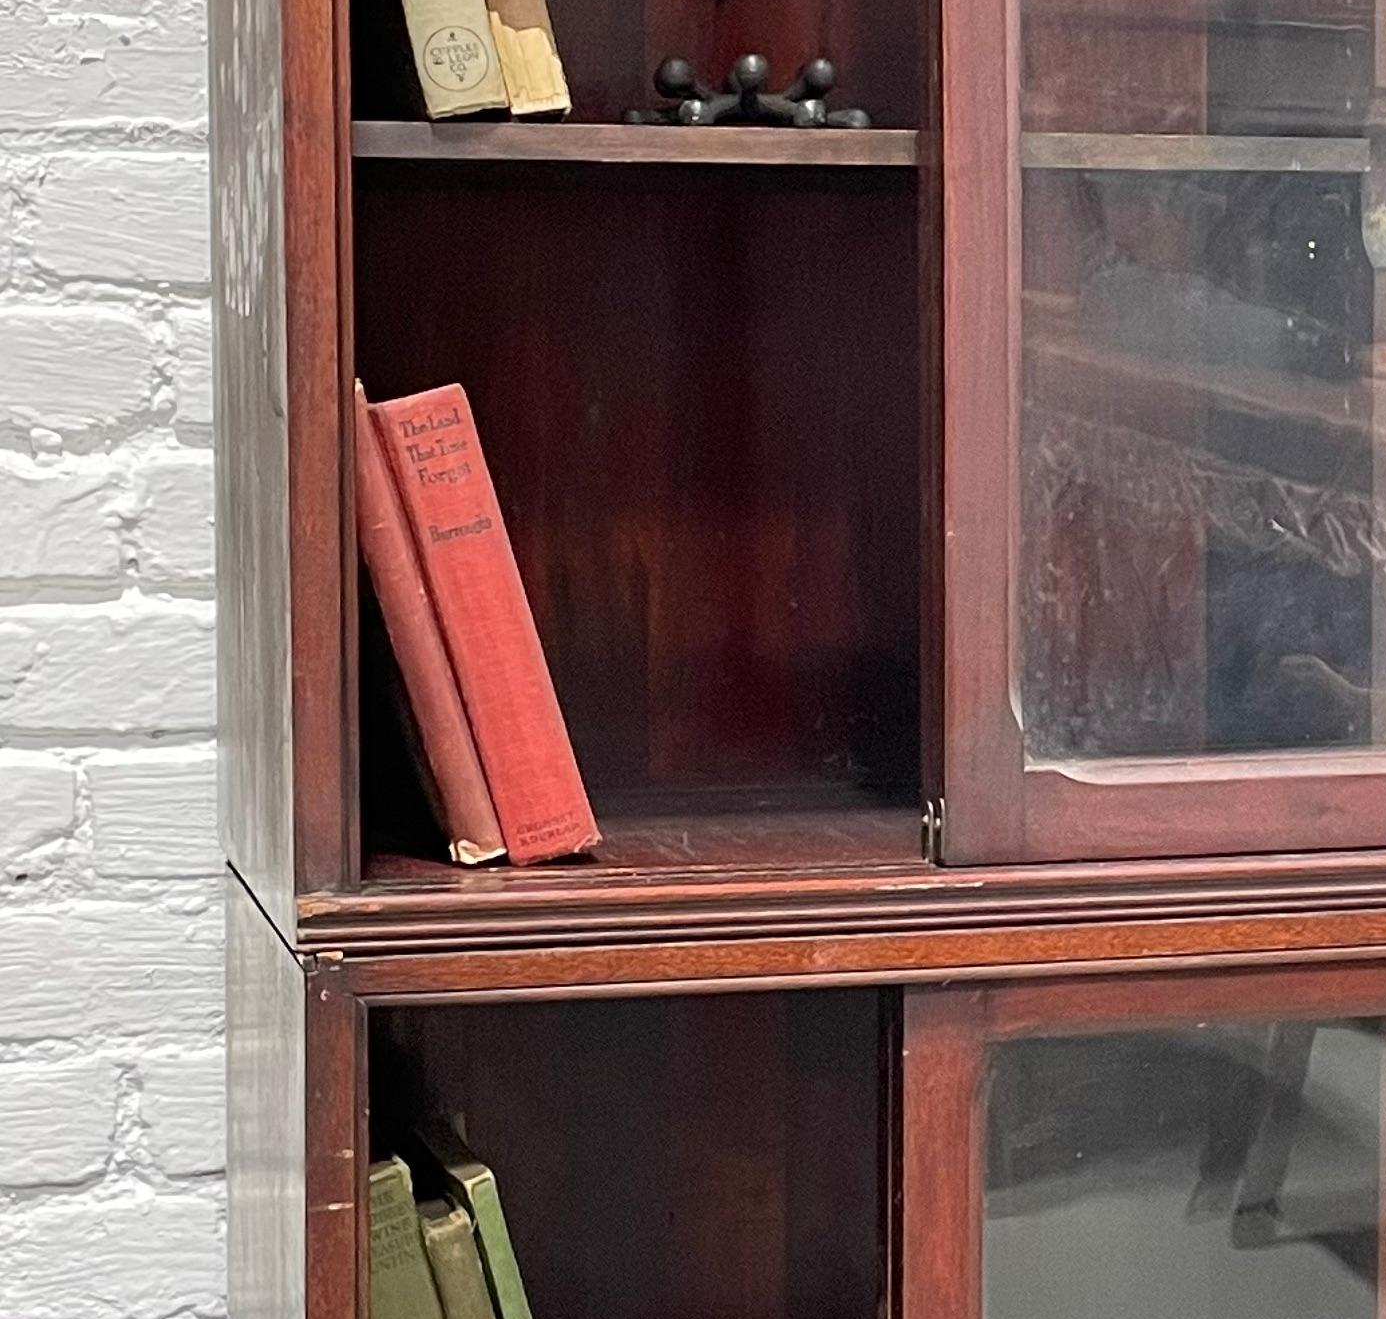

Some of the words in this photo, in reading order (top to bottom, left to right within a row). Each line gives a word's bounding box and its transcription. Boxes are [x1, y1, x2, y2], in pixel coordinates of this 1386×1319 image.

[399, 419, 429, 439] The
[406, 443, 436, 464] That
[434, 437, 467, 457] Time
[418, 462, 471, 486] Forgot
[428, 515, 492, 543] Burroughs
